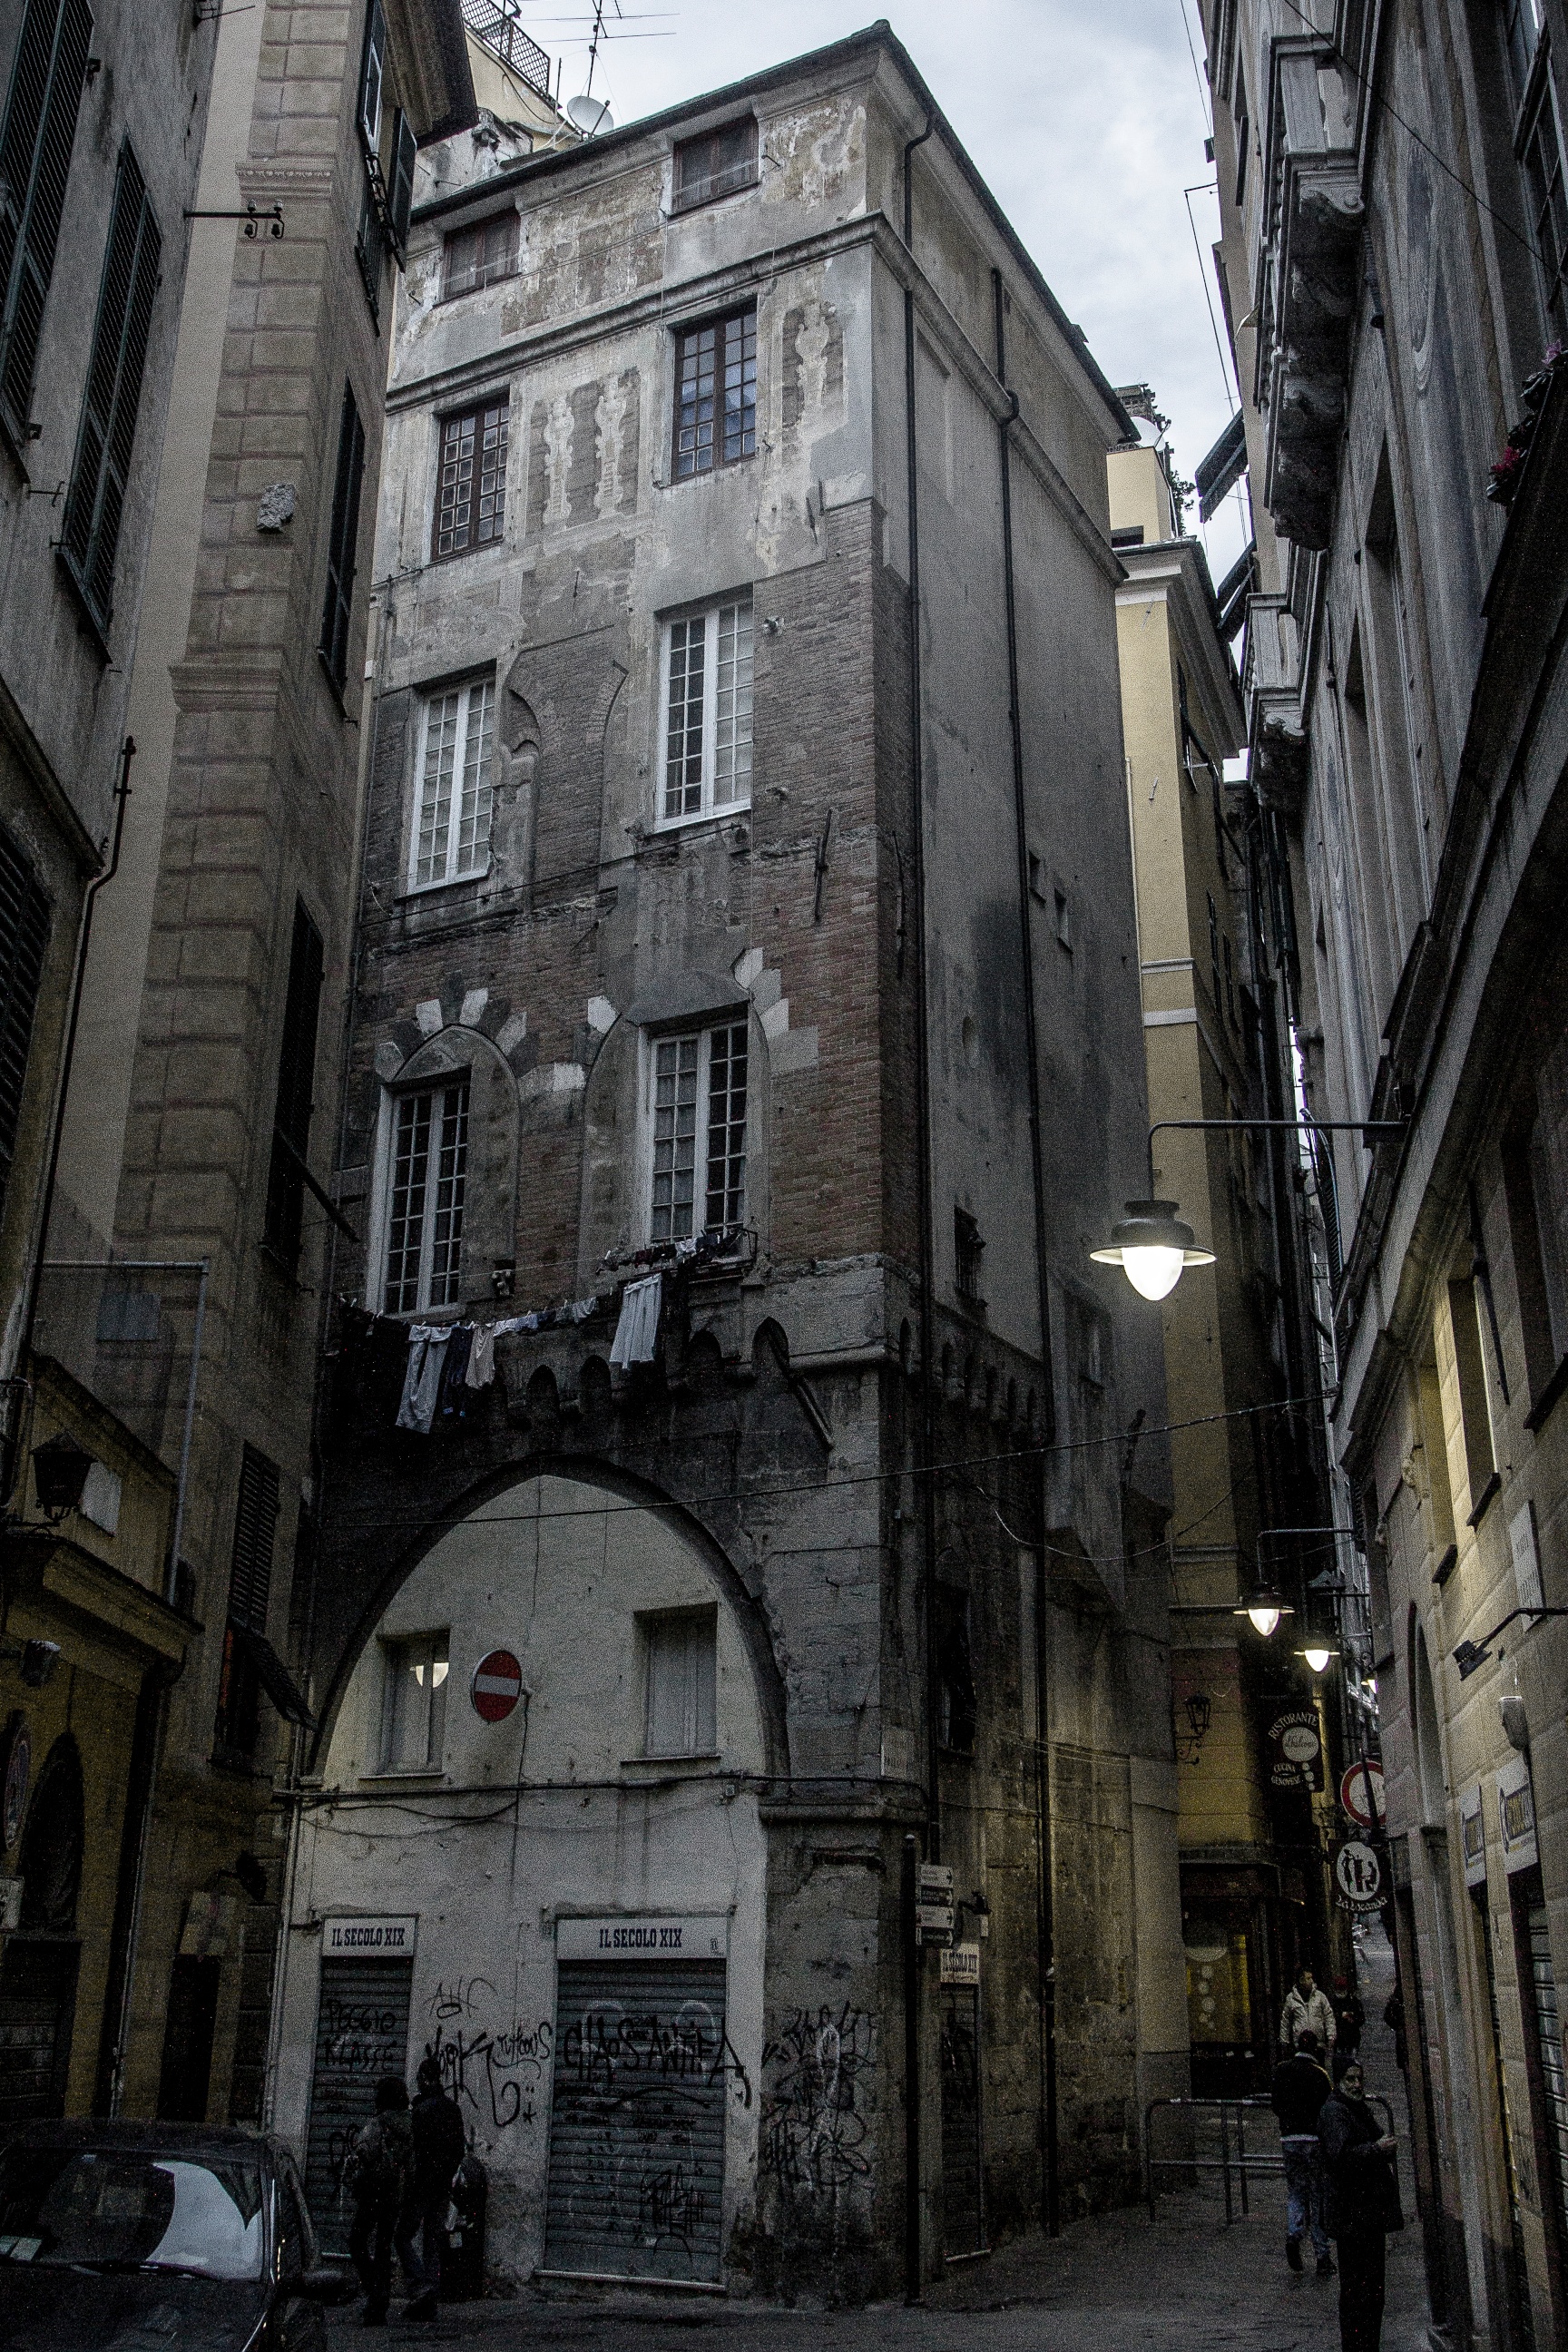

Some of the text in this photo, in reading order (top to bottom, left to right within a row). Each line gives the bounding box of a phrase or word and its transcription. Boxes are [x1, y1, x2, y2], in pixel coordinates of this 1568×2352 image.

[1268, 1711, 1318, 1740] RISTORANTE
[1273, 1762, 1296, 1773] CUCINA
[1270, 1774, 1300, 1786] GENOVESE
[1335, 1894, 1388, 1911] La Locanda
[332, 1927, 405, 1946] IL SECOLO XIX
[599, 1928, 681, 1948] IL SECOLO XIX
